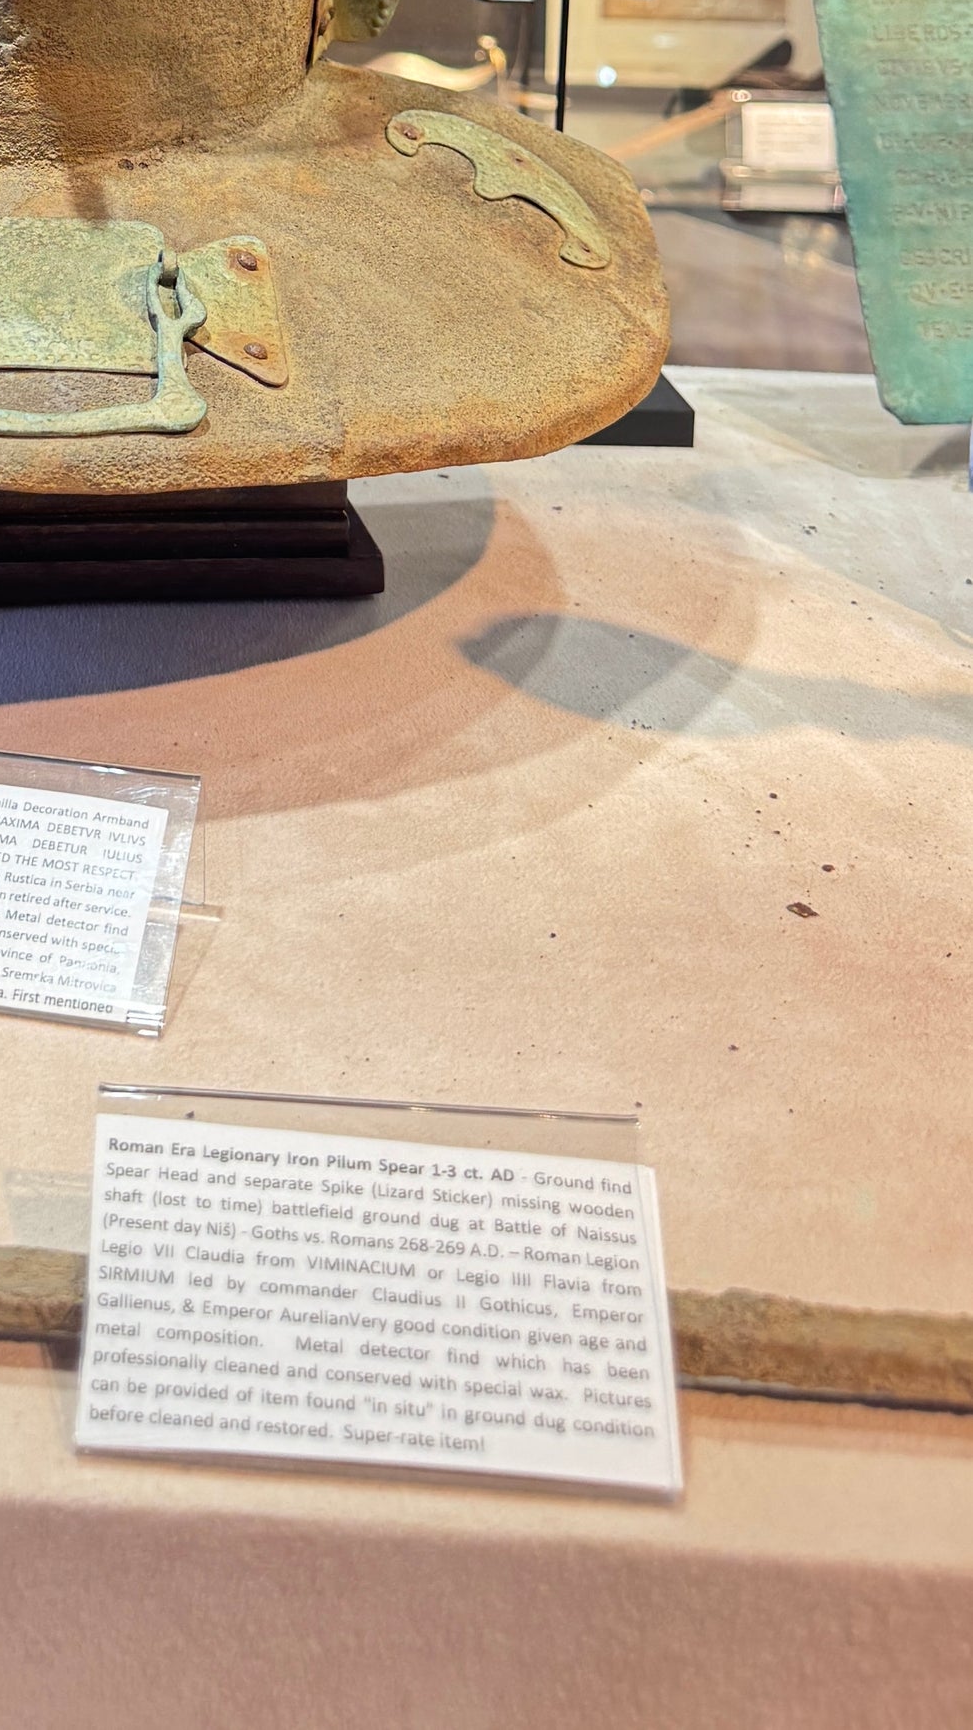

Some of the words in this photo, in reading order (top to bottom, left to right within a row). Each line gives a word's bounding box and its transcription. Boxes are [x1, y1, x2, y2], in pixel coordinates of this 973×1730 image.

[23, 801, 88, 820] Decoration
[92, 812, 150, 829] Armband
[15, 854, 39, 867] THE
[41, 858, 79, 872] MOST
[32, 838, 88, 855] DEBETUR
[4, 871, 47, 887] Rustica
[50, 877, 62, 889] in
[64, 880, 103, 895] Serbia
[106, 1162, 151, 1179] Spear
[158, 1167, 199, 1183] Head
[207, 1172, 236, 1186] and
[244, 1176, 313, 1191] separate
[321, 1179, 364, 1197] Spike
[371, 1182, 424, 1201] (Lizard
[433, 1188, 493, 1209] Sticker)
[501, 1194, 561, 1216] missing
[568, 1202, 635, 1220] wooden
[109, 1137, 164, 1154] Roman
[171, 1142, 196, 1157] Era
[202, 1145, 280, 1167] Legionary
[287, 1151, 319, 1167] Iron
[326, 1155, 372, 1171] Pilum
[379, 1158, 425, 1176] Spear
[431, 1163, 457, 1180] 1-3
[463, 1167, 483, 1181] ct.
[490, 1168, 515, 1183] AD
[533, 1171, 595, 1191] Ground
[600, 1177, 632, 1195] find
[103, 1212, 169, 1232] (Present
[173, 1218, 202, 1237] day
[251, 1225, 299, 1242] Goths
[304, 1232, 325, 1244] vs.
[330, 1230, 395, 1250] Romans
[399, 1236, 466, 1256] 268-269
[469, 1243, 504, 1258] A.D.
[524, 1246, 581, 1265] Roman
[586, 1252, 639, 1272] Legion
[104, 1187, 143, 1204] shaft
[152, 1190, 187, 1208] (lost
[195, 1196, 212, 1209] to
[220, 1197, 263, 1216] time)
[272, 1200, 353, 1221] battlefield
[362, 1210, 421, 1226] ground
[429, 1213, 460, 1233] dug
[469, 1219, 485, 1231] at
[494, 1218, 542, 1236] Battle
[550, 1223, 567, 1238] of
[577, 1226, 637, 1245] Naissus
[99, 1265, 174, 1285] SIRMIUM
[188, 1272, 213, 1290] led
[227, 1275, 245, 1294] by
[259, 1282, 358, 1300] commander
[372, 1287, 442, 1308] Claudius
[479, 1296, 558, 1319] Gothicus,
[572, 1303, 643, 1324] Emperor
[101, 1239, 143, 1259] Legio
[185, 1245, 245, 1264] Claudia
[256, 1251, 295, 1268] from
[307, 1255, 415, 1278] VIMINACIUM
[427, 1268, 444, 1280] or
[457, 1268, 500, 1288] Legio
[543, 1274, 591, 1293] Flavia
[601, 1278, 642, 1297] from
